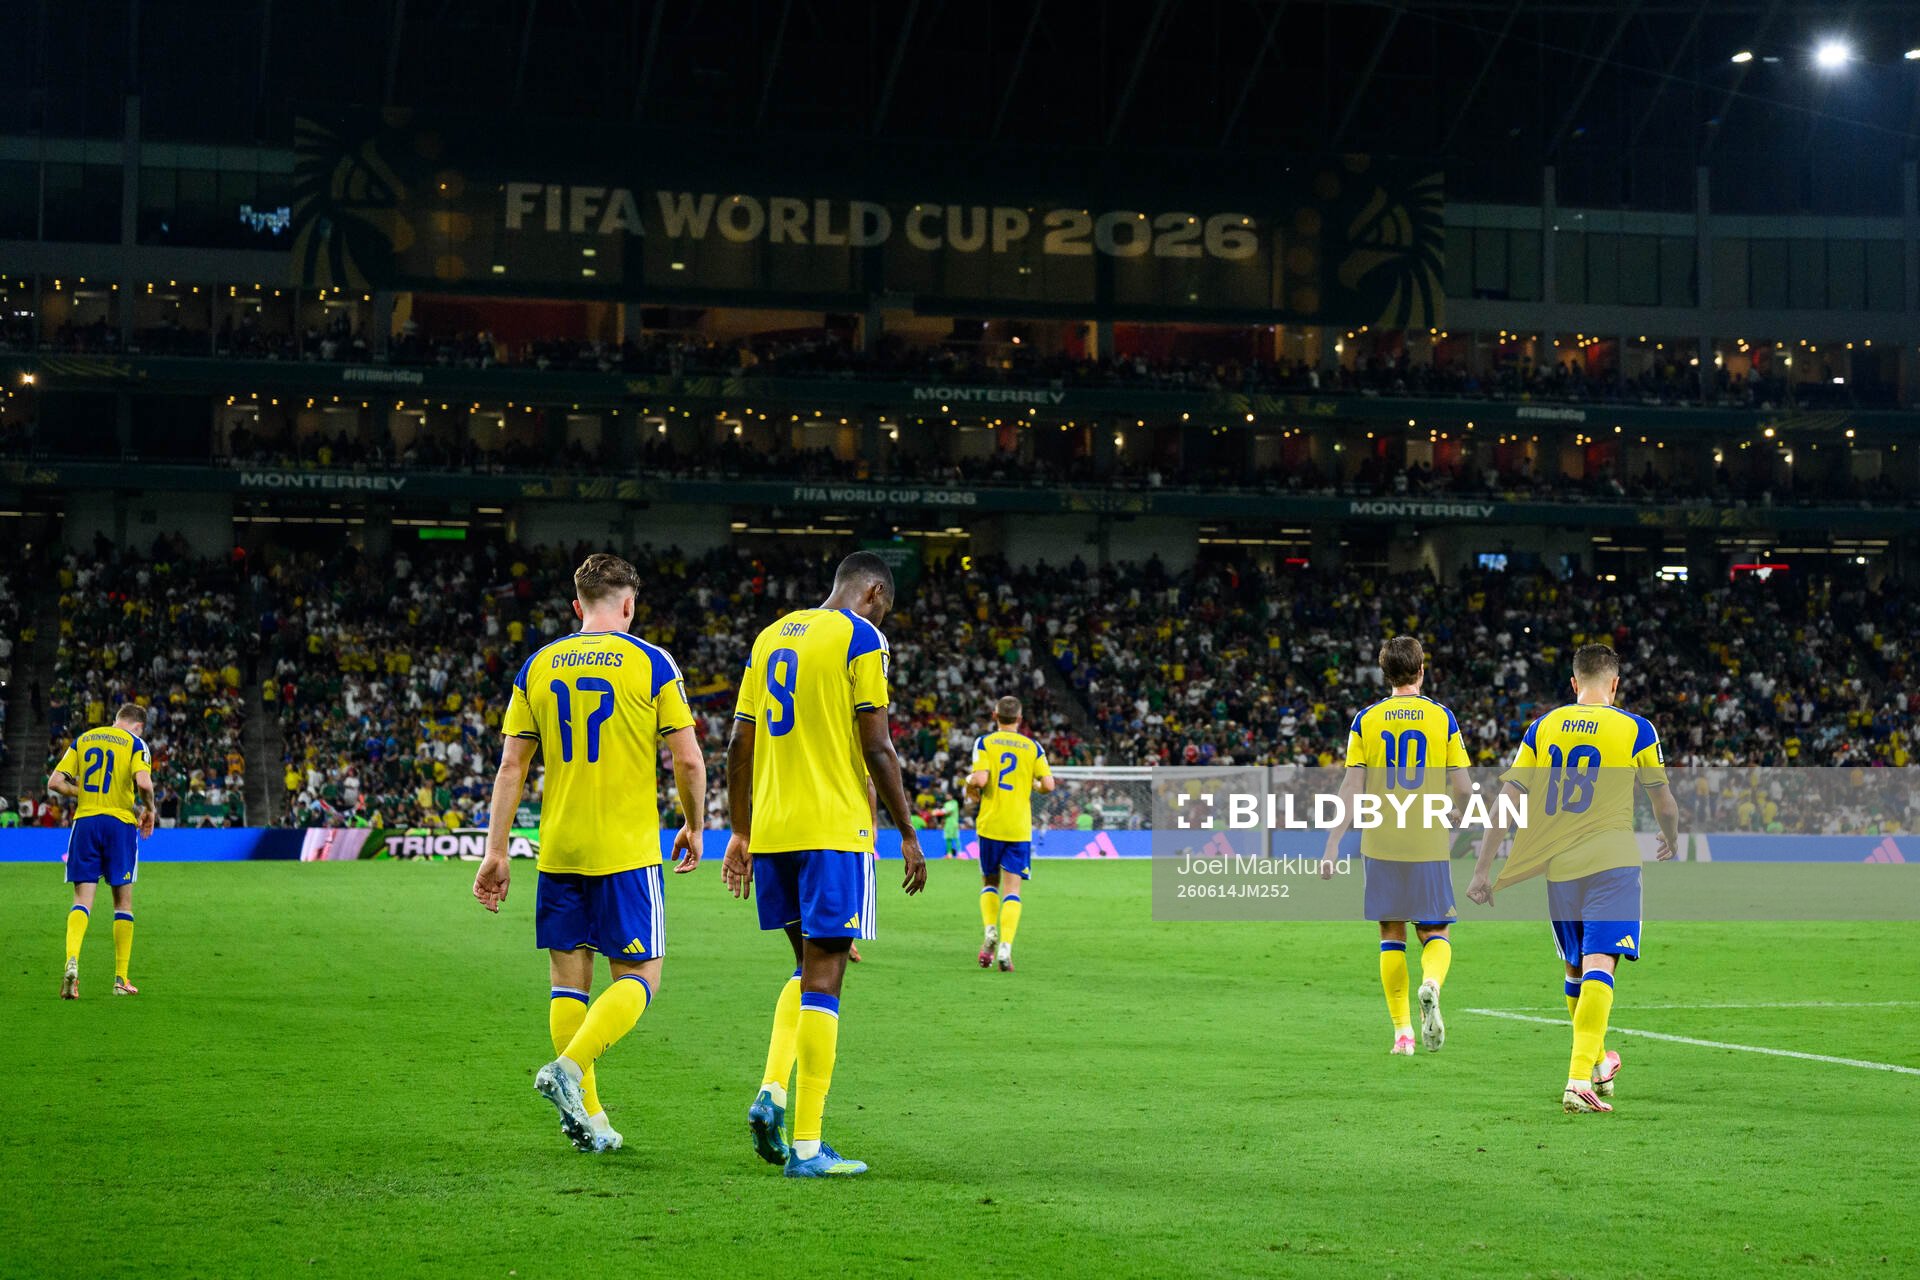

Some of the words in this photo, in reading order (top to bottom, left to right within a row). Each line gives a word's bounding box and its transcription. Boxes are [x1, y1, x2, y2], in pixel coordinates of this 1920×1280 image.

[504, 181, 646, 237] FIFA
[656, 189, 892, 248] WORLD
[904, 202, 1031, 254] CUP
[1042, 208, 1260, 260] 2026
[912, 387, 1067, 405] MONTERREY
[239, 472, 408, 491] MONTERREY
[792, 487, 828, 501] FIFA
[828, 488, 887, 503] WORLD
[888, 489, 921, 504] CUP
[922, 490, 978, 505] 2026
[1349, 501, 1496, 518] MONTERREY
[779, 622, 810, 637] ISAK
[551, 649, 624, 669] GYÖKERES
[765, 648, 799, 737] 9
[549, 676, 615, 763] 17
[1384, 709, 1424, 721] NYGREN
[1561, 719, 1599, 735] AYARI
[83, 746, 115, 795] 21
[1380, 729, 1428, 790] 10
[997, 751, 1018, 791] 2
[1544, 743, 1602, 816] 18
[384, 834, 535, 858] TRIONA
